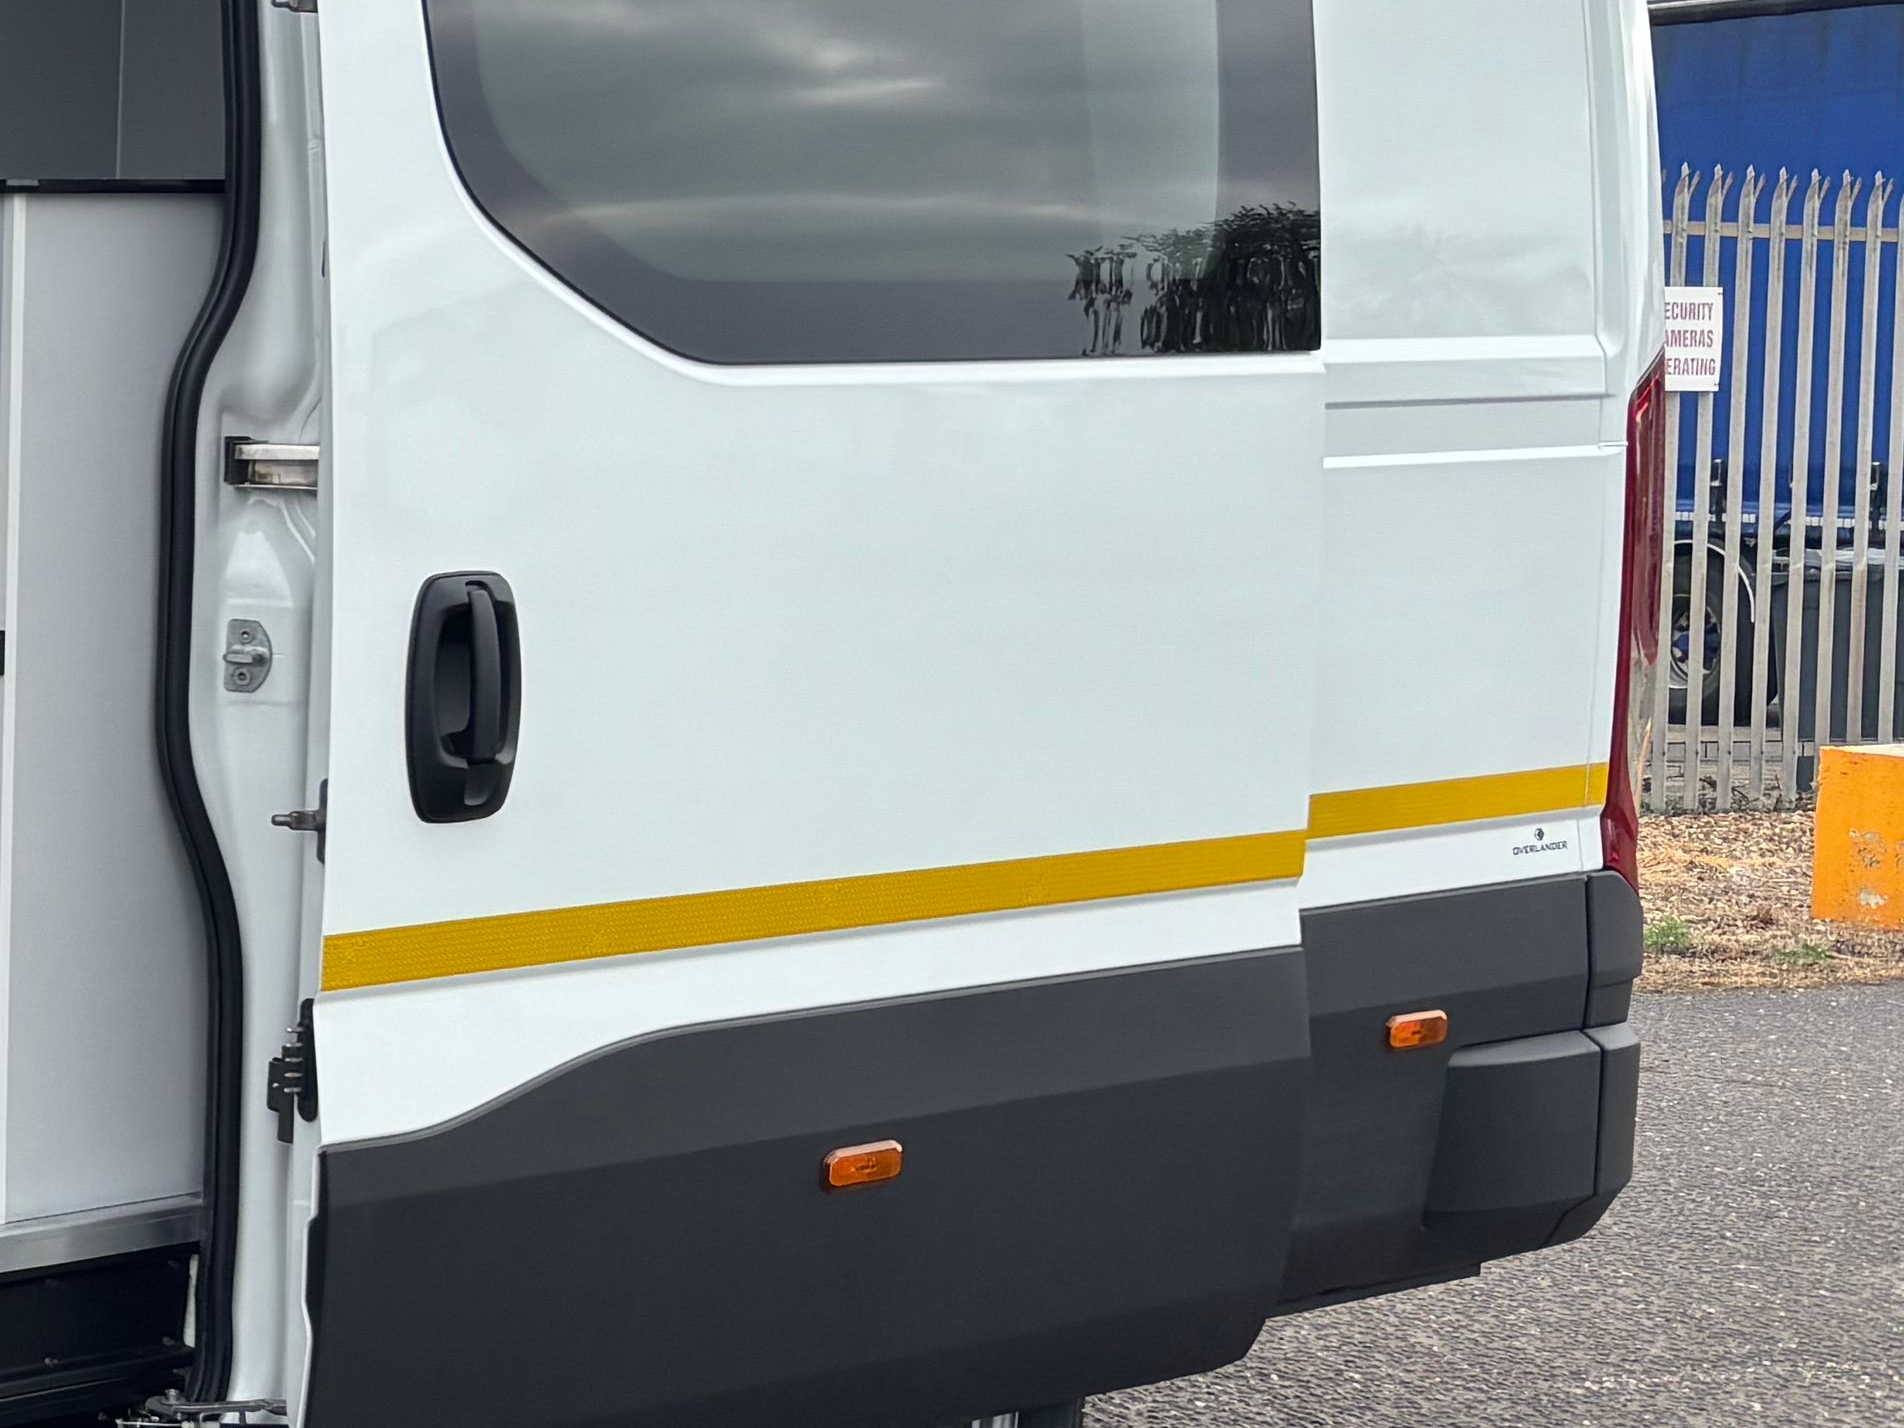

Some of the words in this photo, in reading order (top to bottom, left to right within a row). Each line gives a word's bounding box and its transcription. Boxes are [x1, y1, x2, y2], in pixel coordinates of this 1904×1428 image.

[1664, 302, 1714, 321] ECURITY
[1664, 329, 1714, 349] AMERAS
[1665, 357, 1716, 376] ERATING
